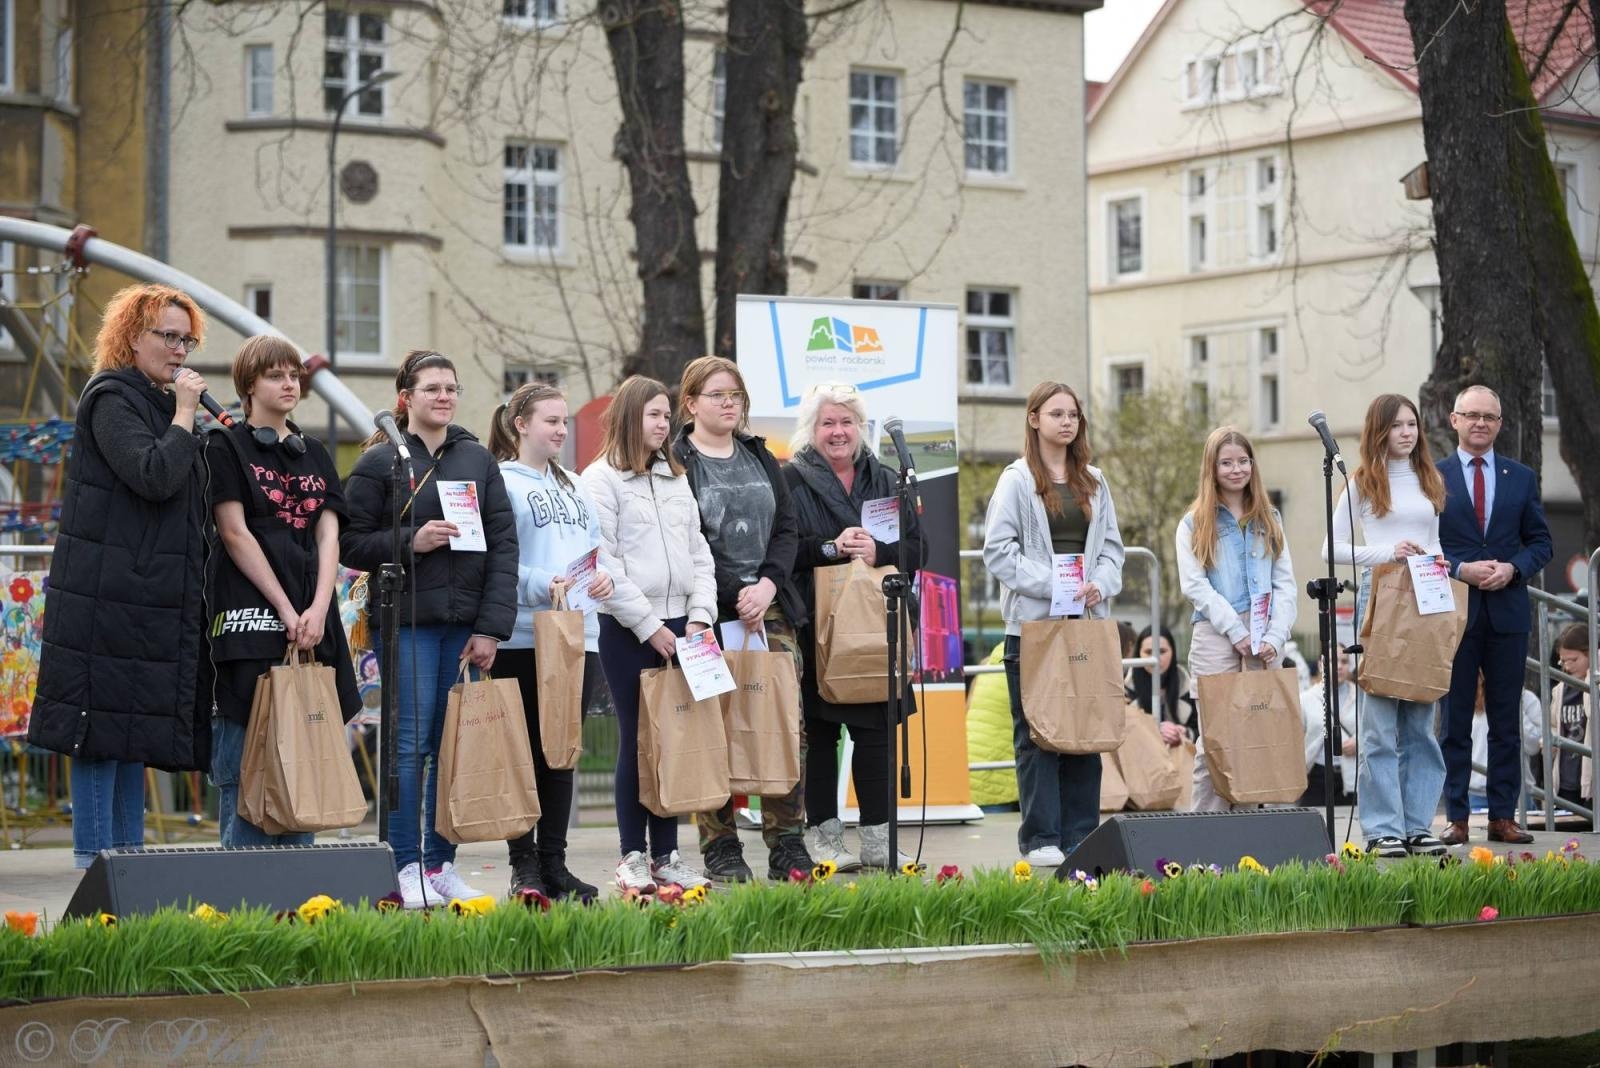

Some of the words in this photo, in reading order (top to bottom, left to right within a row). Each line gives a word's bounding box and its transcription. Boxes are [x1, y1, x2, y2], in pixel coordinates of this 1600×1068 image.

[805, 355, 837, 366] powiat
[842, 356, 885, 366] raciborski
[226, 607, 273, 620] WELL
[221, 619, 286, 634] FITNESS
